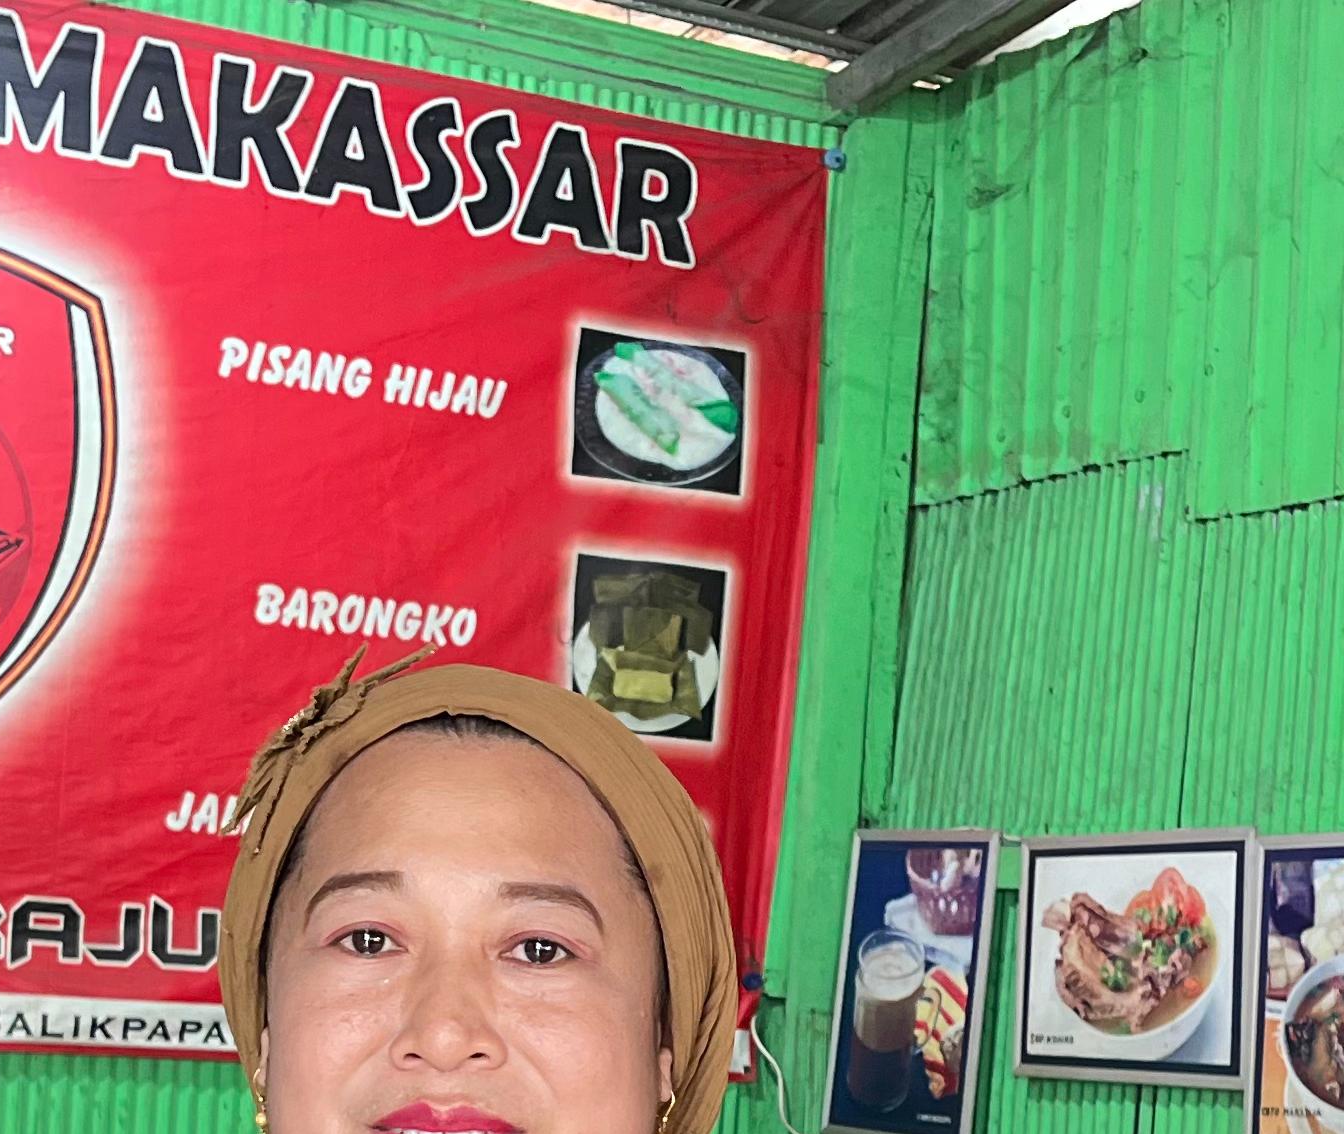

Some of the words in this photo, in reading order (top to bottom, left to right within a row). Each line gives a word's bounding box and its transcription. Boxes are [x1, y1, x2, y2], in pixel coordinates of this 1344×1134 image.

[218, 337, 371, 399] PISANG
[384, 363, 507, 420] HIJAU
[255, 584, 478, 648] BARONGKO
